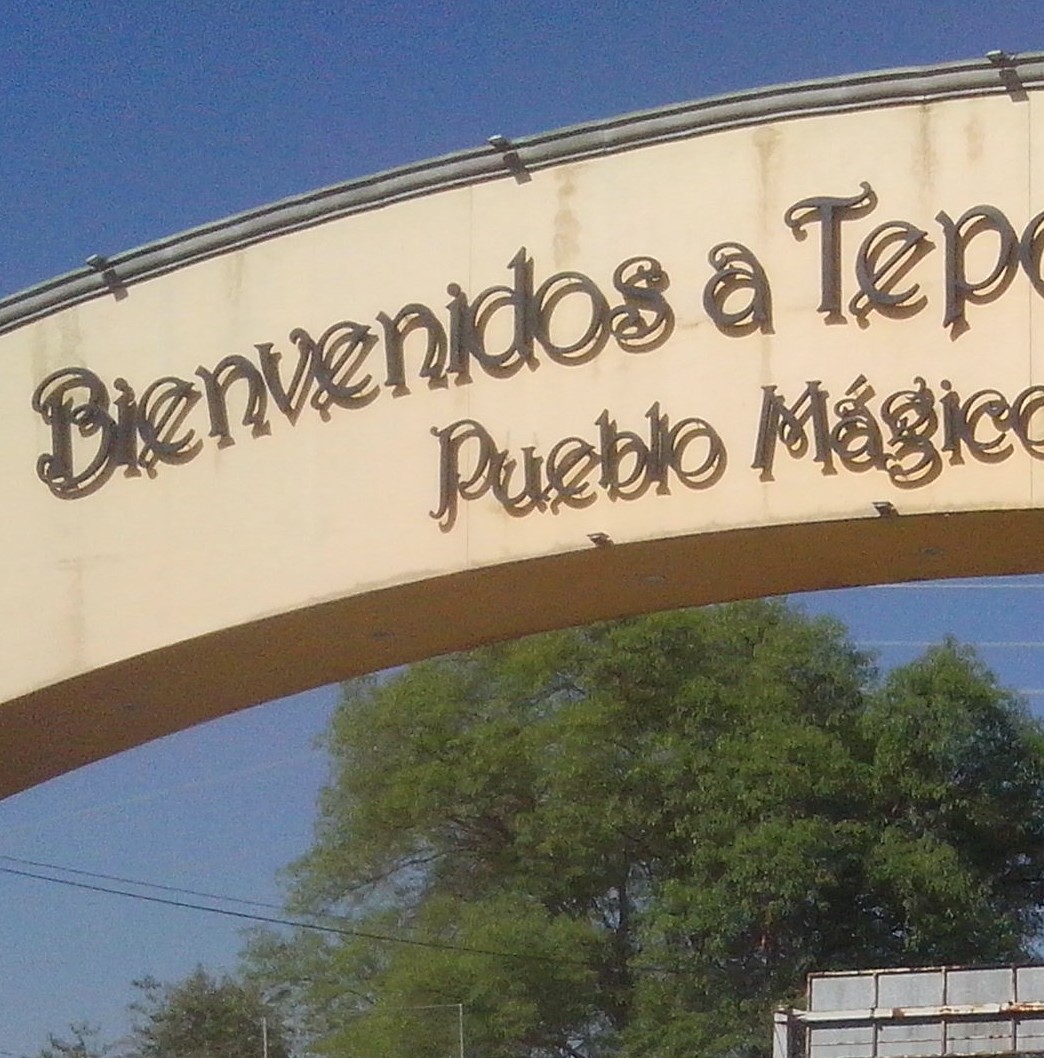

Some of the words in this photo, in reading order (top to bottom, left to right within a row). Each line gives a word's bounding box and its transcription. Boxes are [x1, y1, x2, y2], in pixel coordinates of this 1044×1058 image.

[32, 246, 675, 500] Bienvenidos
[703, 241, 775, 338] a
[430, 401, 728, 534] Pueblo
